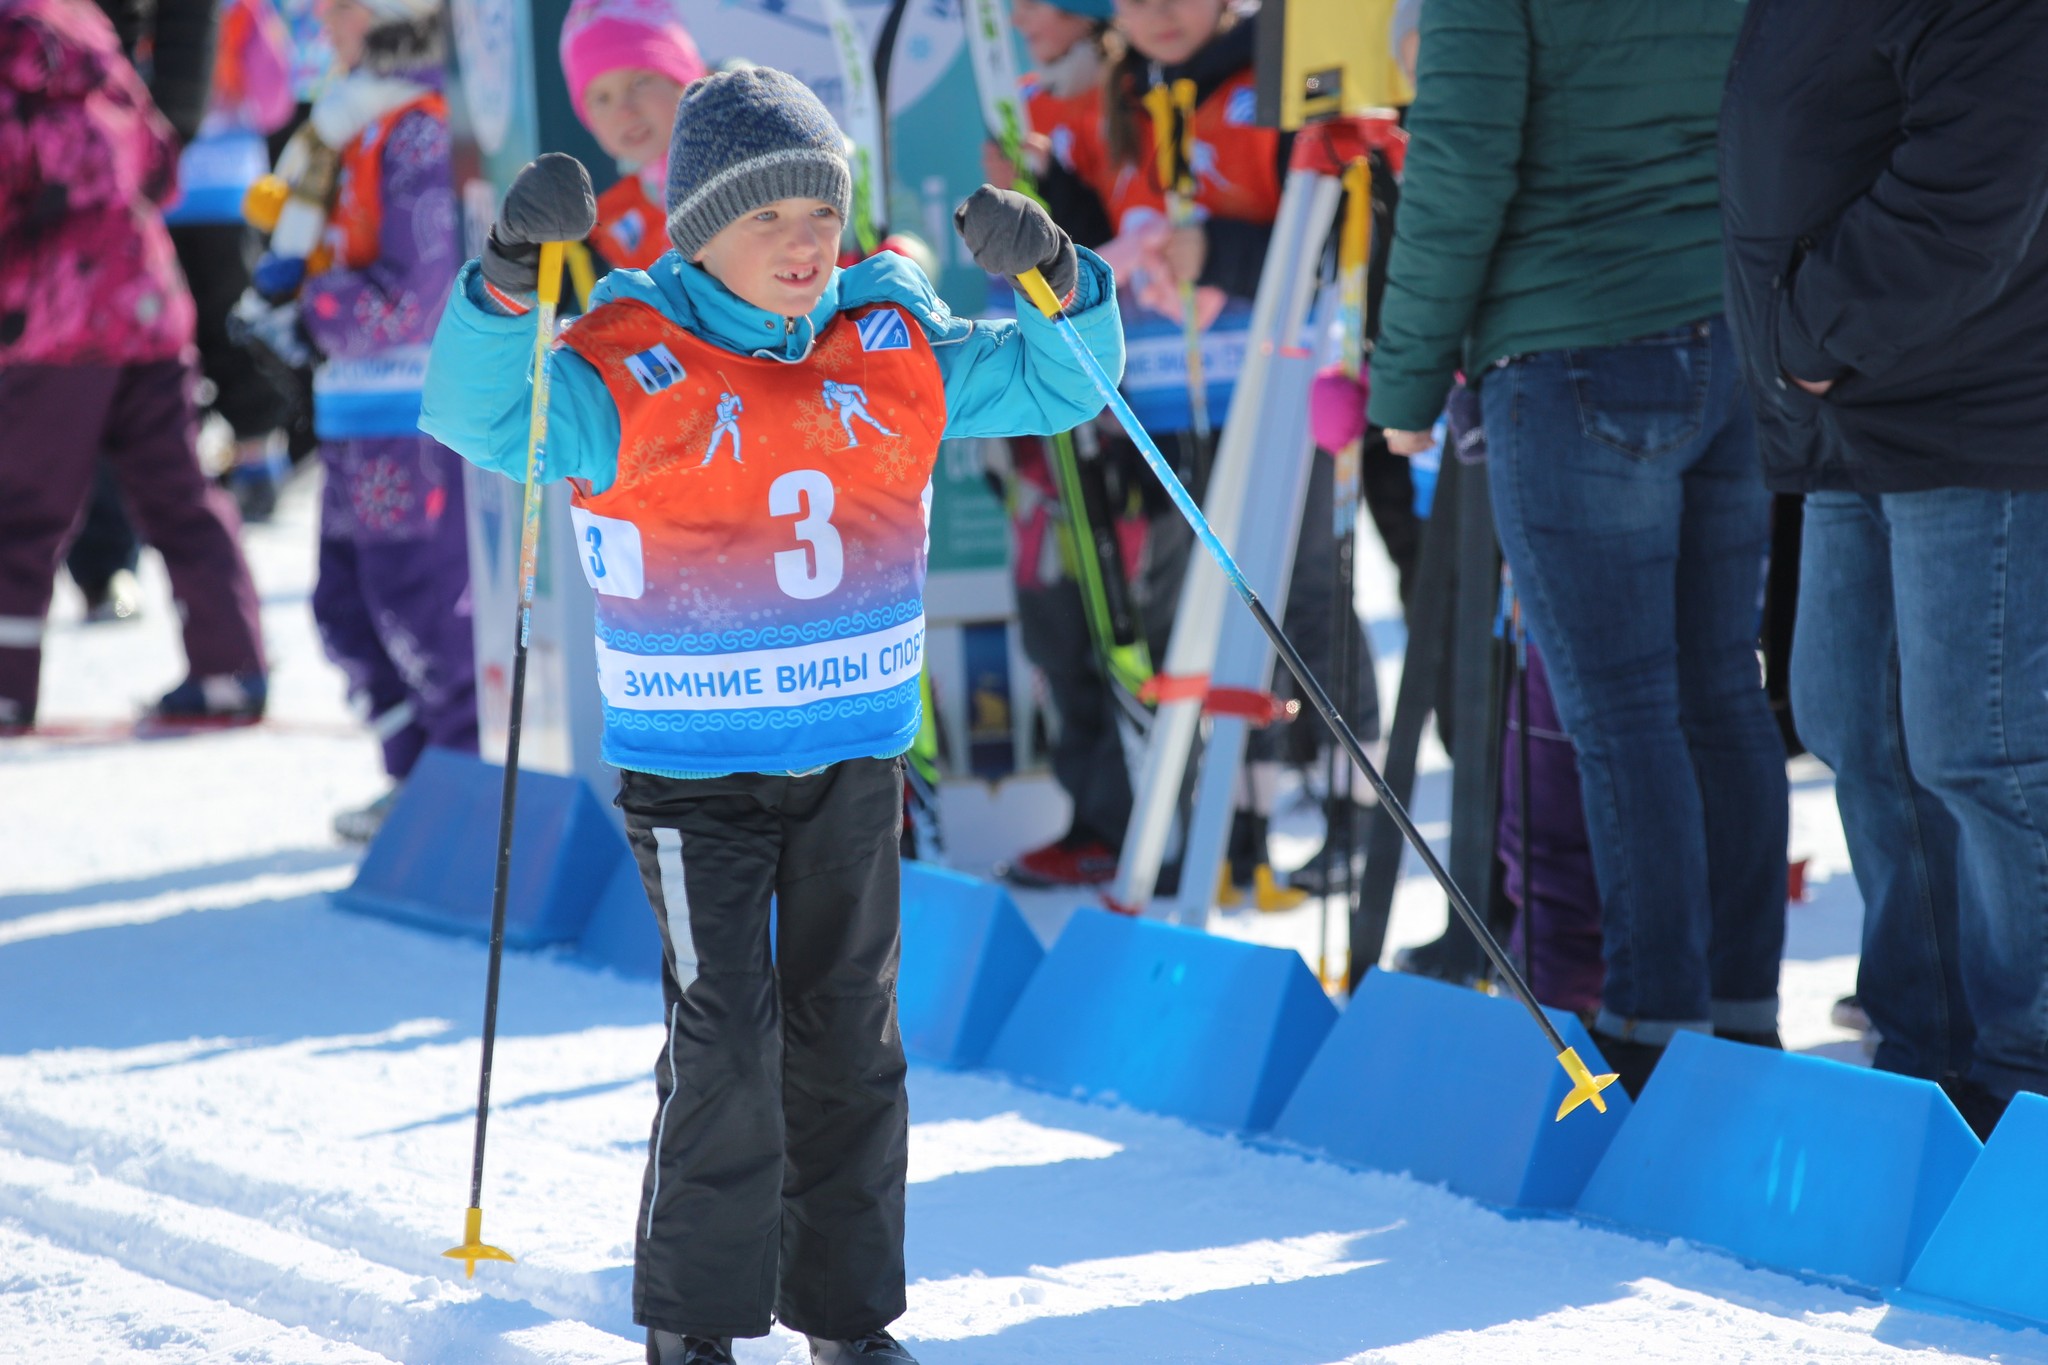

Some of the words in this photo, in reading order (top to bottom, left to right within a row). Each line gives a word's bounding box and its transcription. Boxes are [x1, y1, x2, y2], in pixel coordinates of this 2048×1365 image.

[586, 525, 606, 578] 3
[768, 469, 844, 600] 3
[624, 669, 763, 697] ЗИМНИЕ
[776, 652, 868, 694] ВИДЫ
